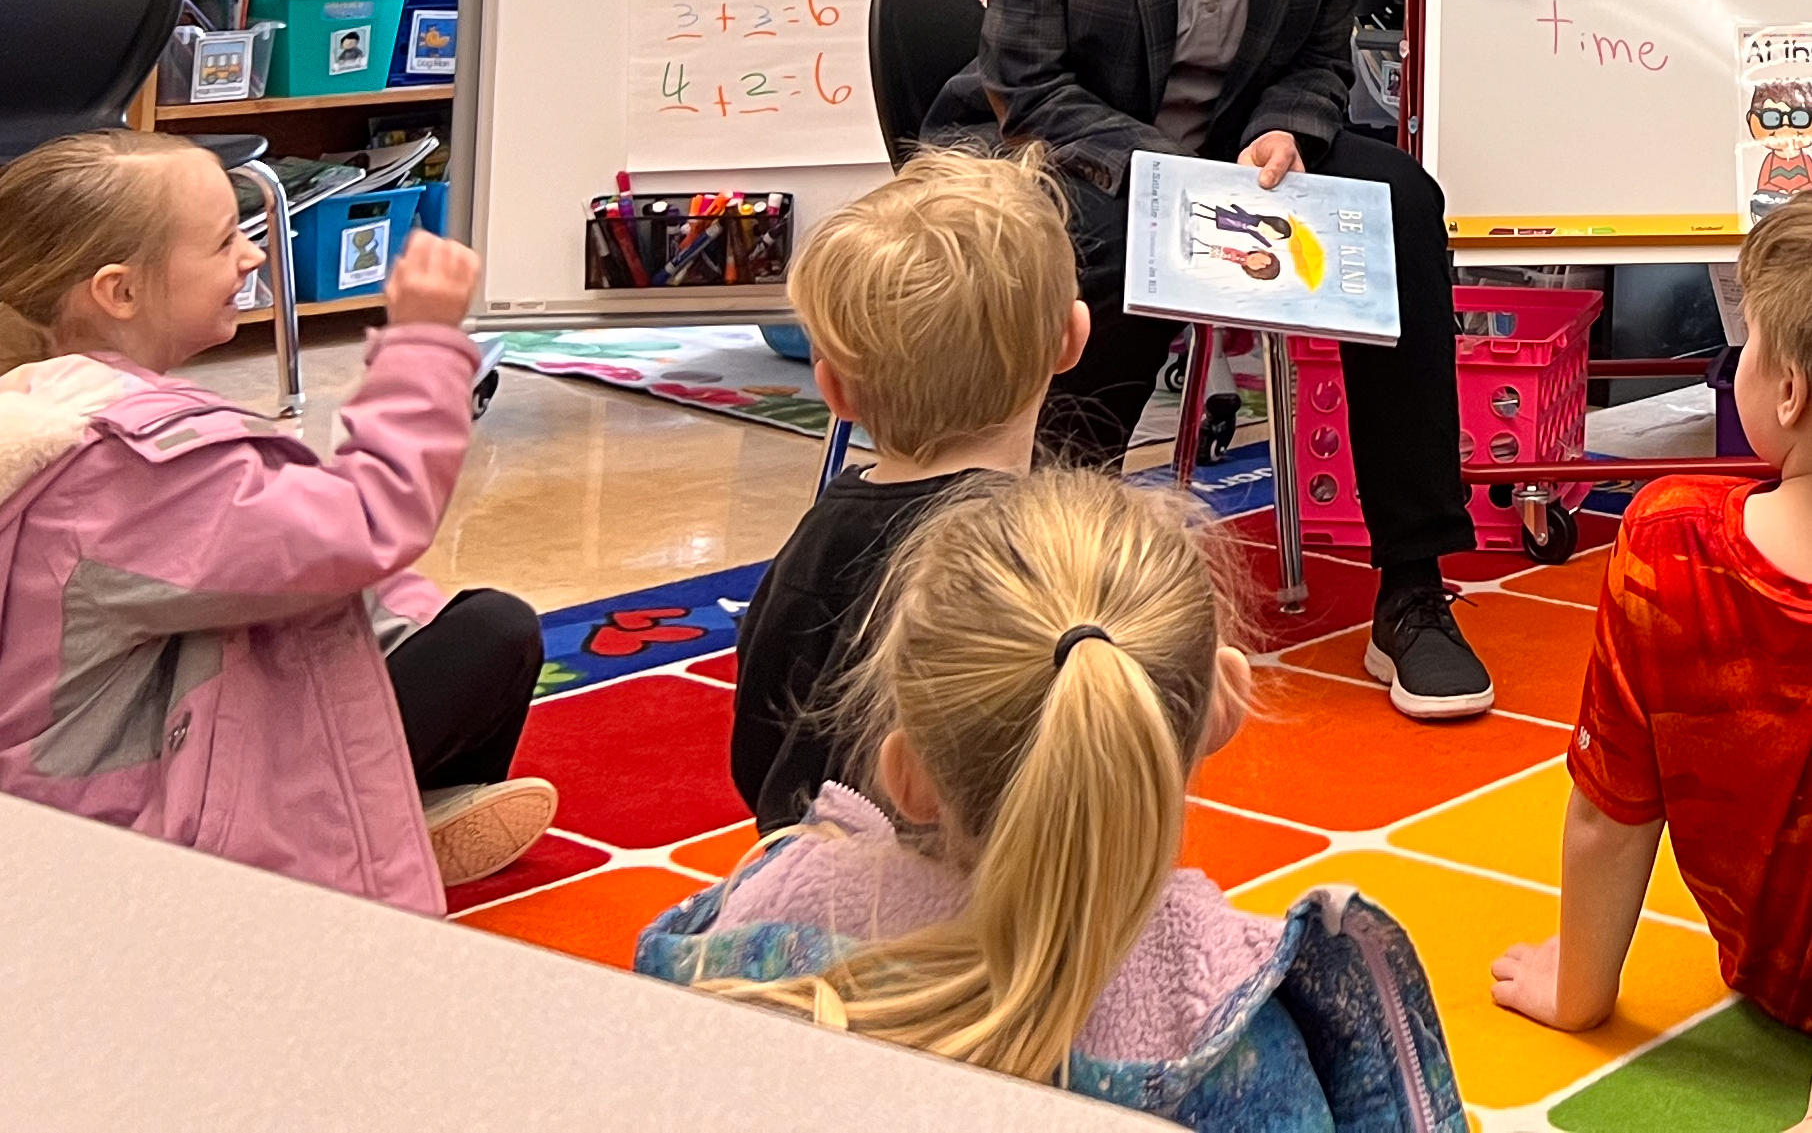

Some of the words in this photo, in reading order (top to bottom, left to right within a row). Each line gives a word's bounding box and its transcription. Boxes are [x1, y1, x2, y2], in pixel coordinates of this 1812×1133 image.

[673, 3, 699, 29] 3
[754, 4, 773, 29] 3
[1537, 0, 1669, 71] time
[662, 61, 690, 104] 4
[740, 72, 778, 96] 2
[815, 52, 852, 104] 6
[1338, 209, 1364, 234] BE
[1340, 245, 1368, 294] KIND
